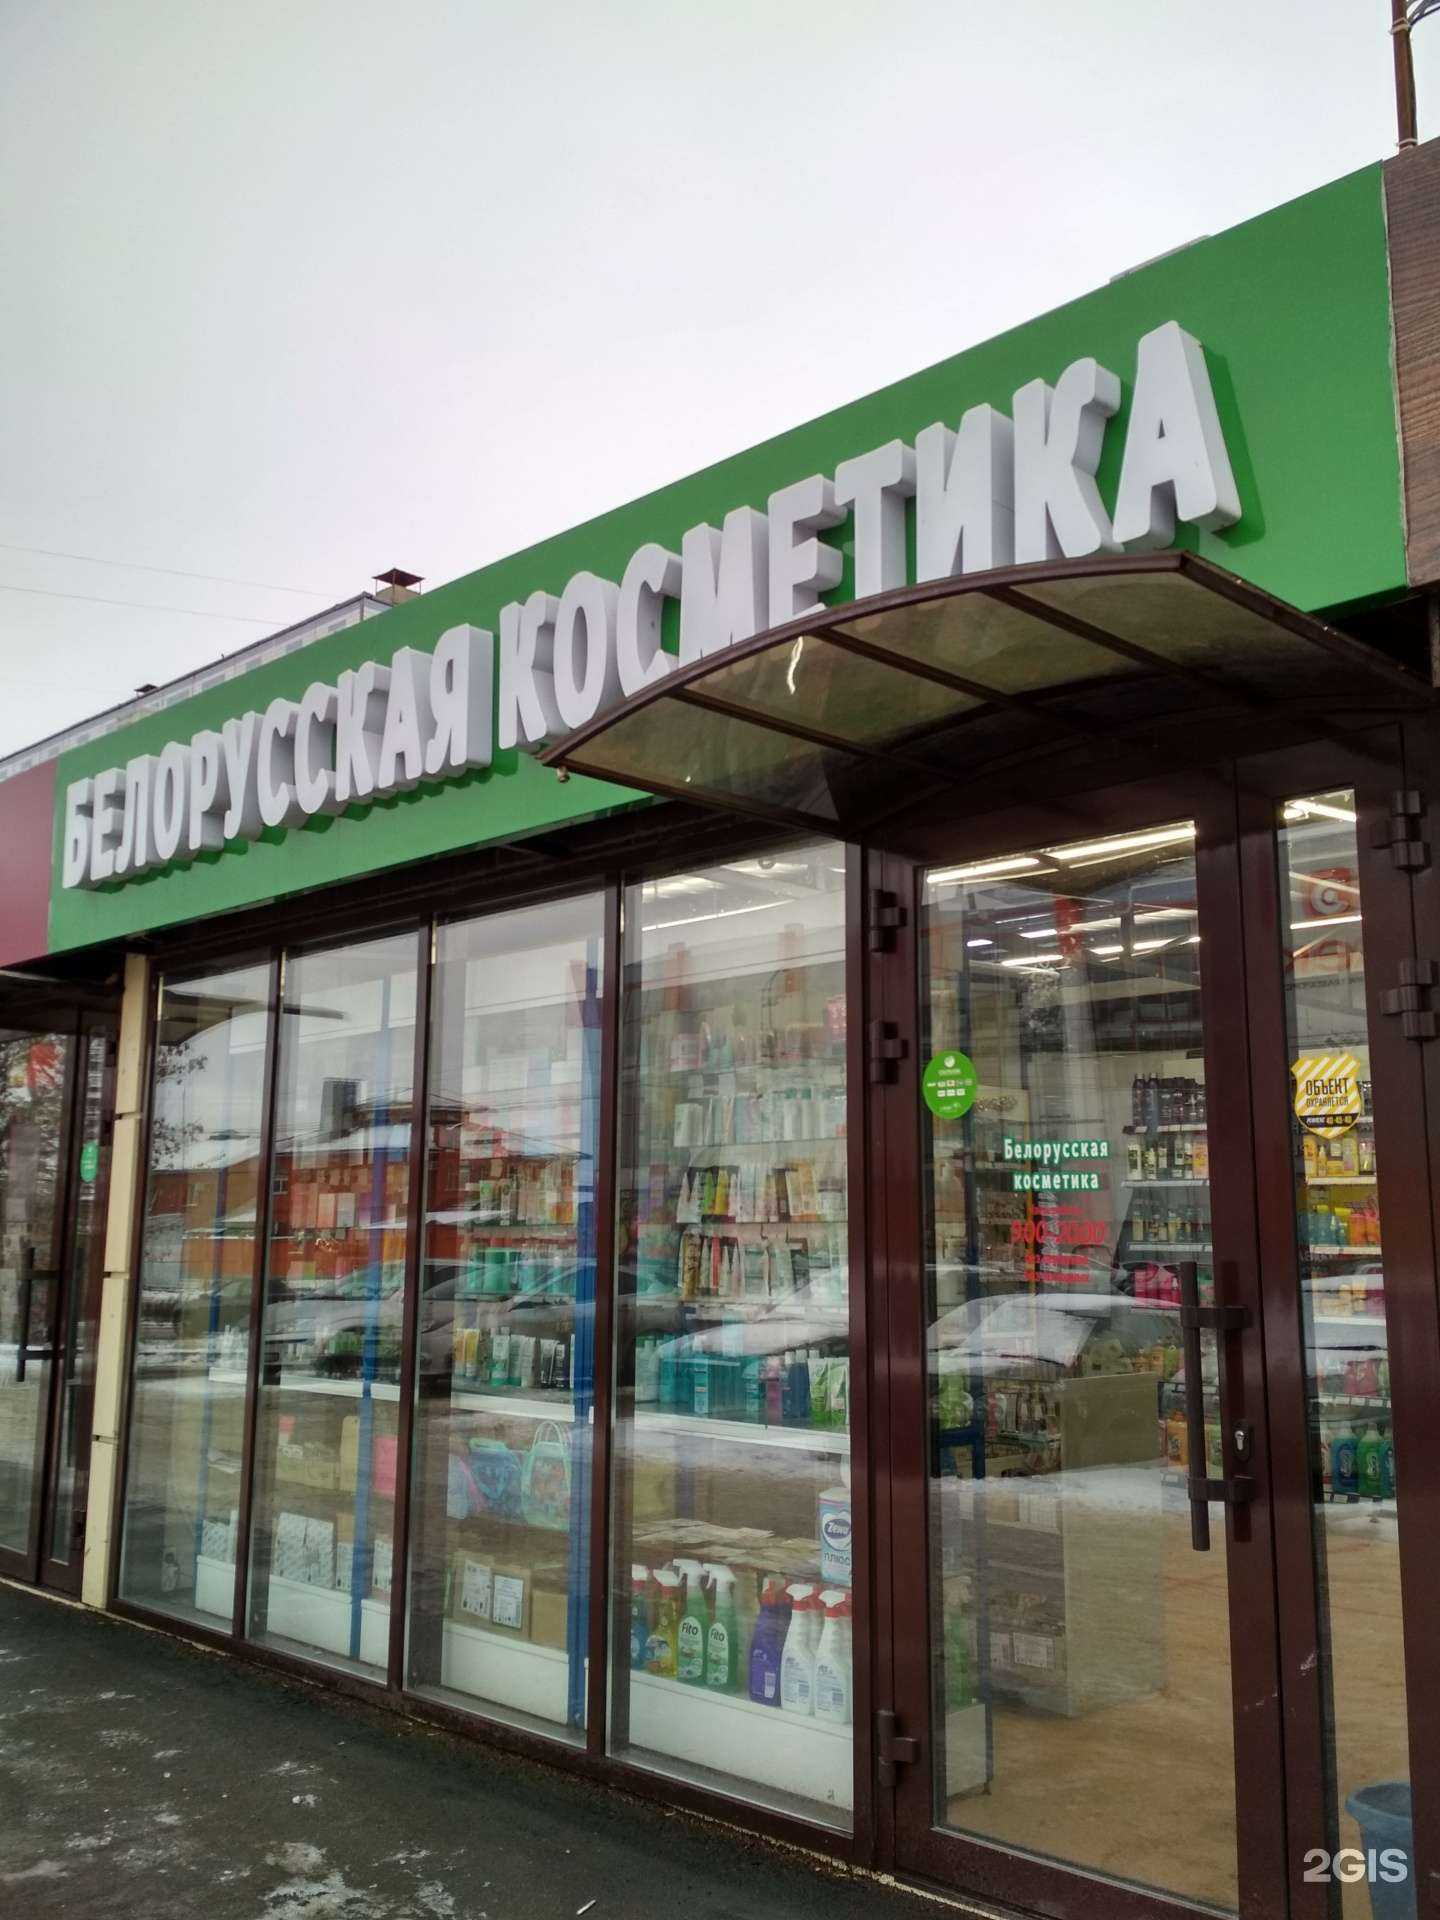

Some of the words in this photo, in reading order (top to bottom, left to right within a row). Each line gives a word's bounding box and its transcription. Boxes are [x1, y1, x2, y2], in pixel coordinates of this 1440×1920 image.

[62, 623, 494, 889] БЕЛОРУССКАЯ
[499, 320, 1241, 750] КОСМЕТИКА
[1305, 1077, 1349, 1096] ОБЪЕКТ
[1003, 1138, 1108, 1164] Белорусская
[1013, 1171, 1099, 1190] косметика
